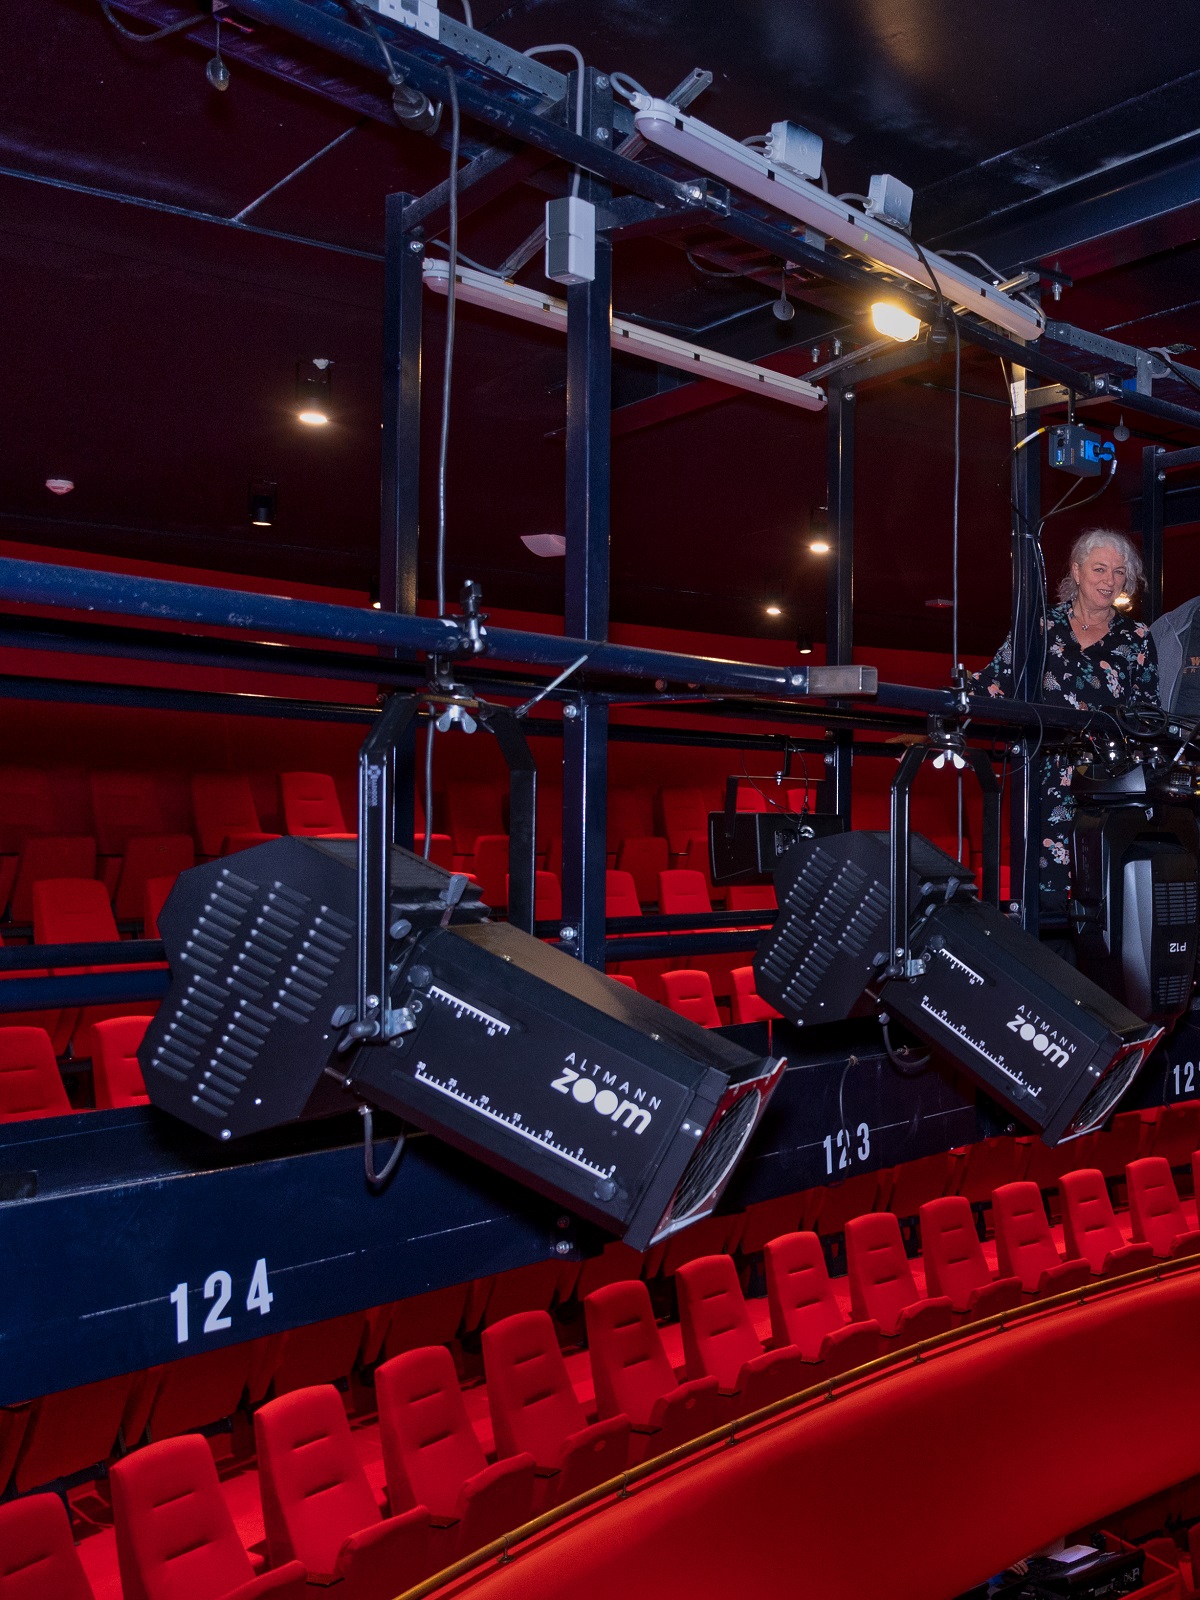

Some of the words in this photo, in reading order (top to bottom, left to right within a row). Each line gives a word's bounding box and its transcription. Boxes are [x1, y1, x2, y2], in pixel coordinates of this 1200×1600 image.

[1169, 942, 1187, 953] P12
[1006, 1014, 1070, 1069] zoom
[1017, 1004, 1077, 1054] ALTMANN
[416, 1061, 426, 1071] 30
[448, 1077, 458, 1087] 25
[480, 1094, 490, 1105] 20
[513, 1112, 522, 1122] 15
[550, 1067, 652, 1135] zoom
[565, 1052, 662, 1110] ALTMANN
[823, 1122, 870, 1175] 123
[170, 1257, 274, 1345] 124
